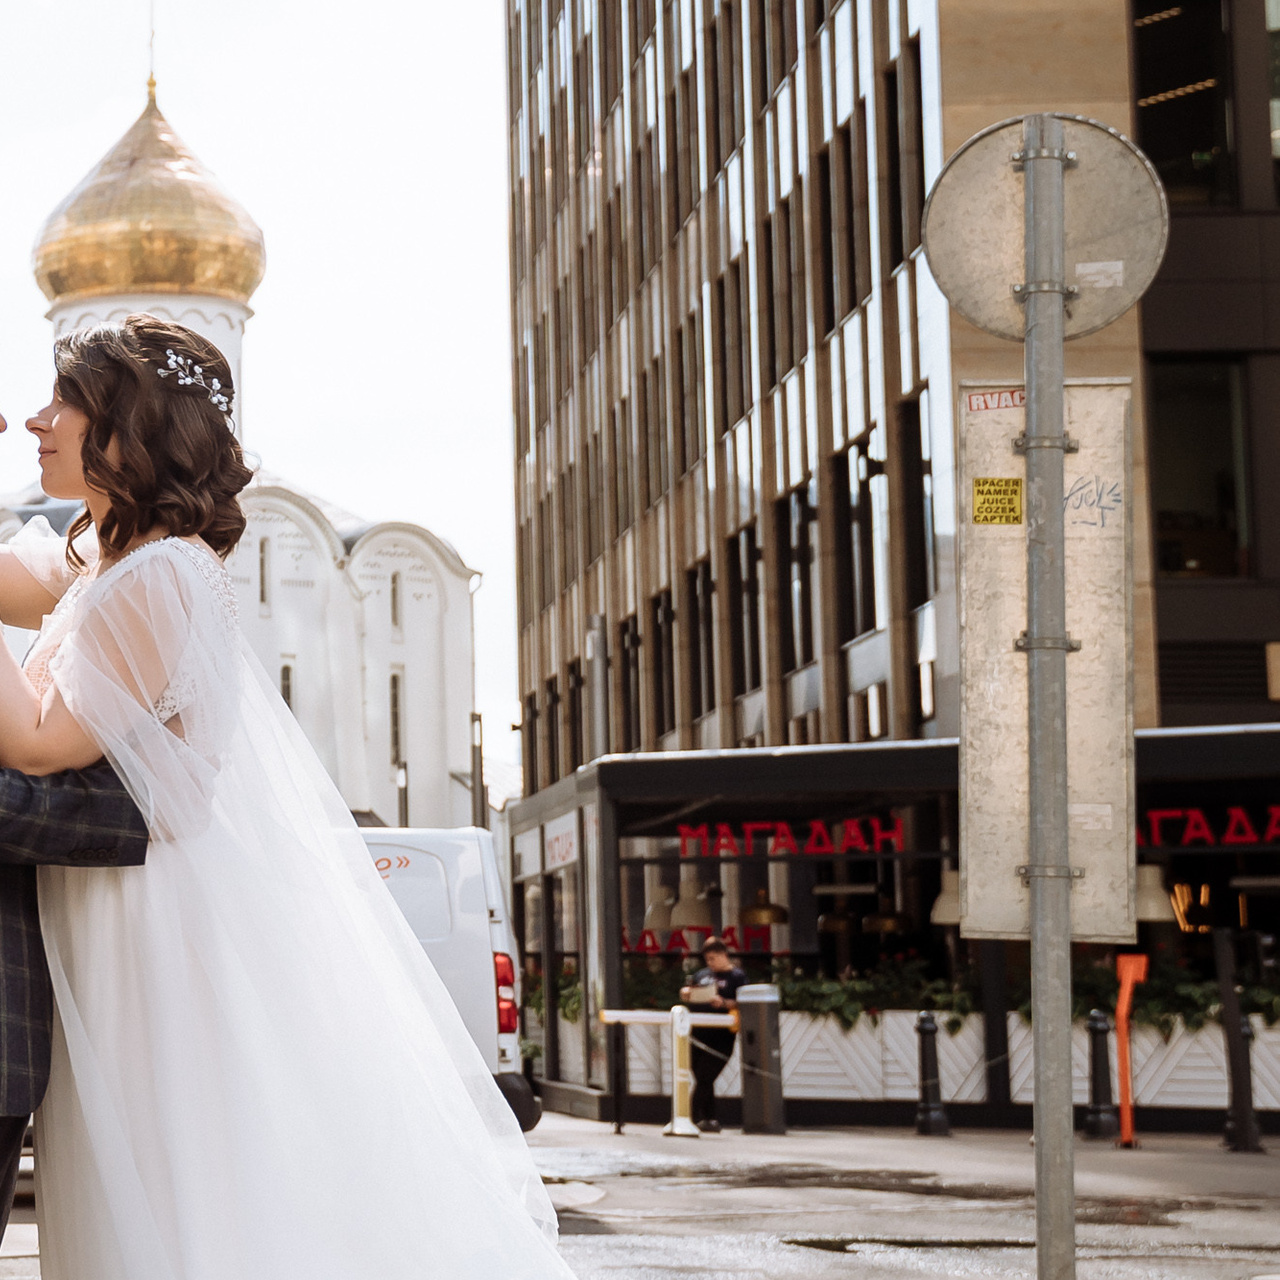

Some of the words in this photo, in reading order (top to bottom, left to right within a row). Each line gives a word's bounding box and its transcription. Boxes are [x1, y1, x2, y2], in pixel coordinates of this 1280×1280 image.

[974, 479, 1020, 487] SPACER
[976, 488, 1018, 496] NAMER
[979, 497, 1014, 505] JUICE
[1136, 806, 1280, 846] ГАДА
[678, 818, 904, 856] МАГАДАН
